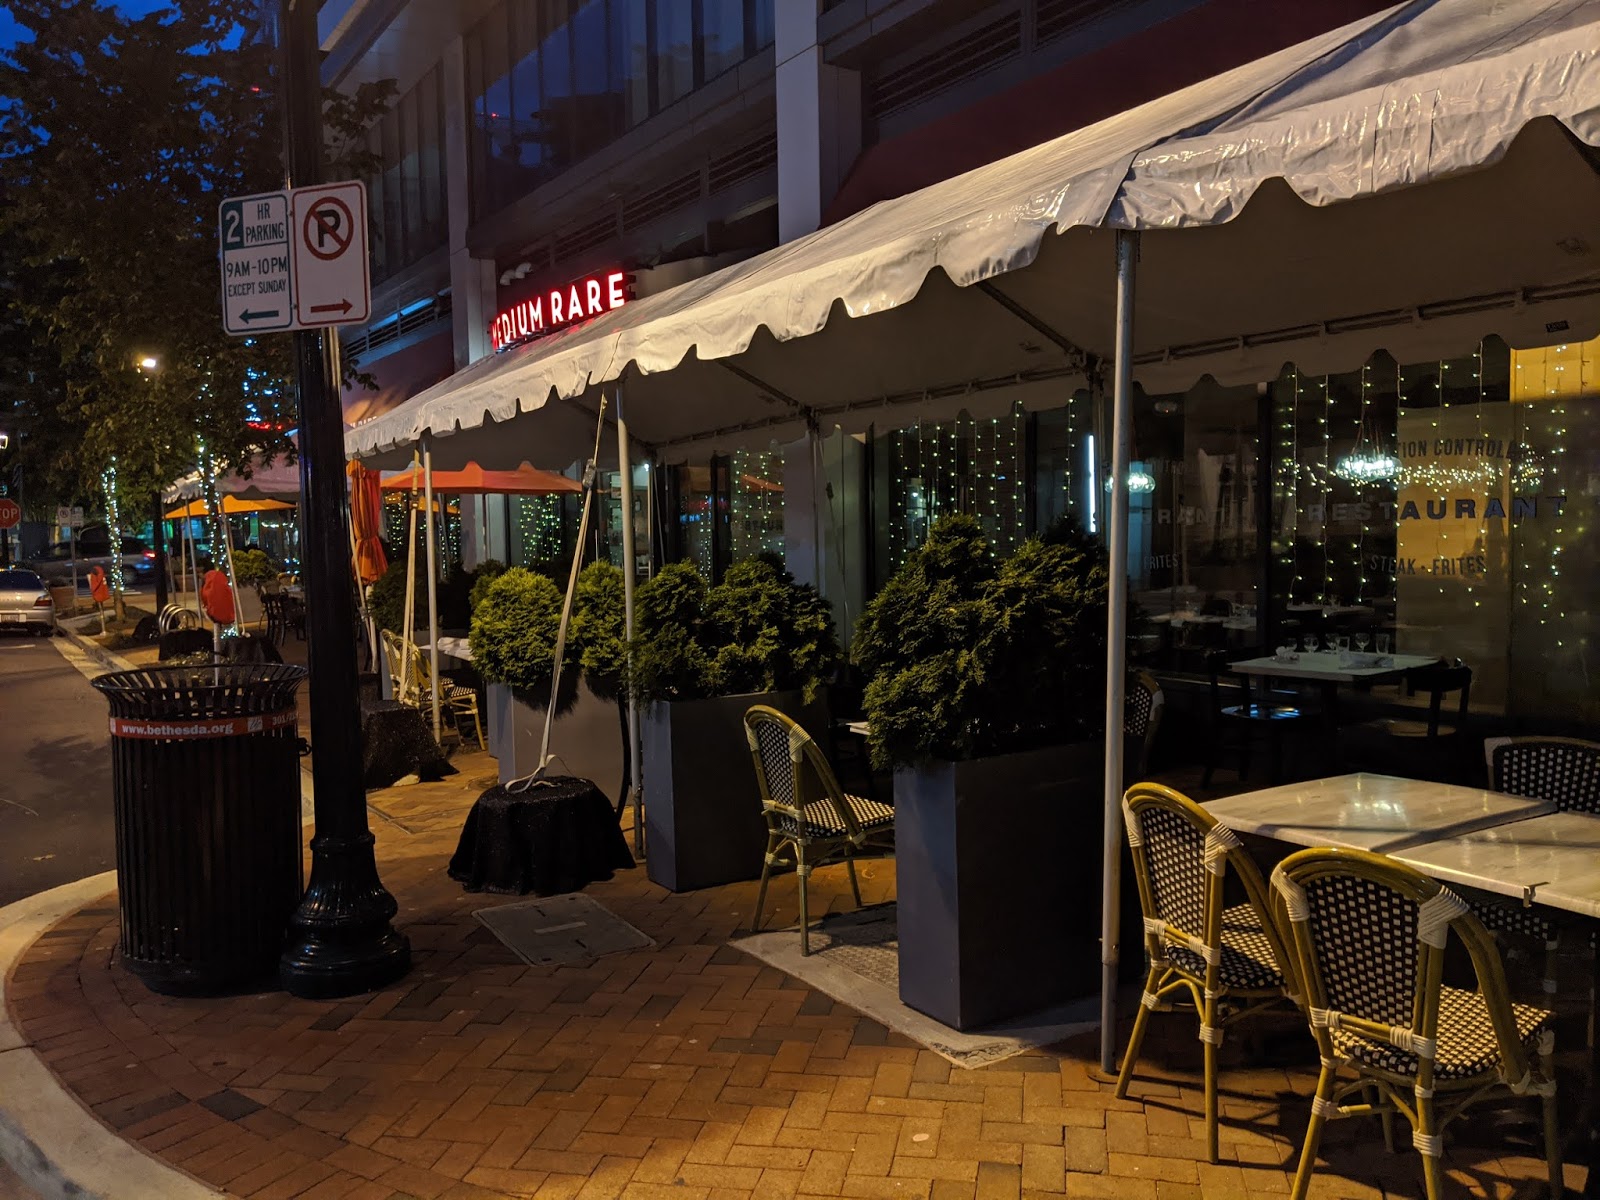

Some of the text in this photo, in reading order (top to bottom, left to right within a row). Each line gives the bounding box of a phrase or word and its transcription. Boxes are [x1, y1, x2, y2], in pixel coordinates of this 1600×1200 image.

[257, 203, 271, 220] HR
[225, 209, 241, 244] 2
[245, 222, 285, 243] PARKING
[228, 278, 287, 298] EXCEPT SUNDAY
[492, 272, 625, 350] MEDIUM RARE
[1308, 496, 1568, 522] RESTAURANT
[1370, 554, 1487, 576] STEAK FRITES
[121, 721, 235, 736] www.bethesda.org
